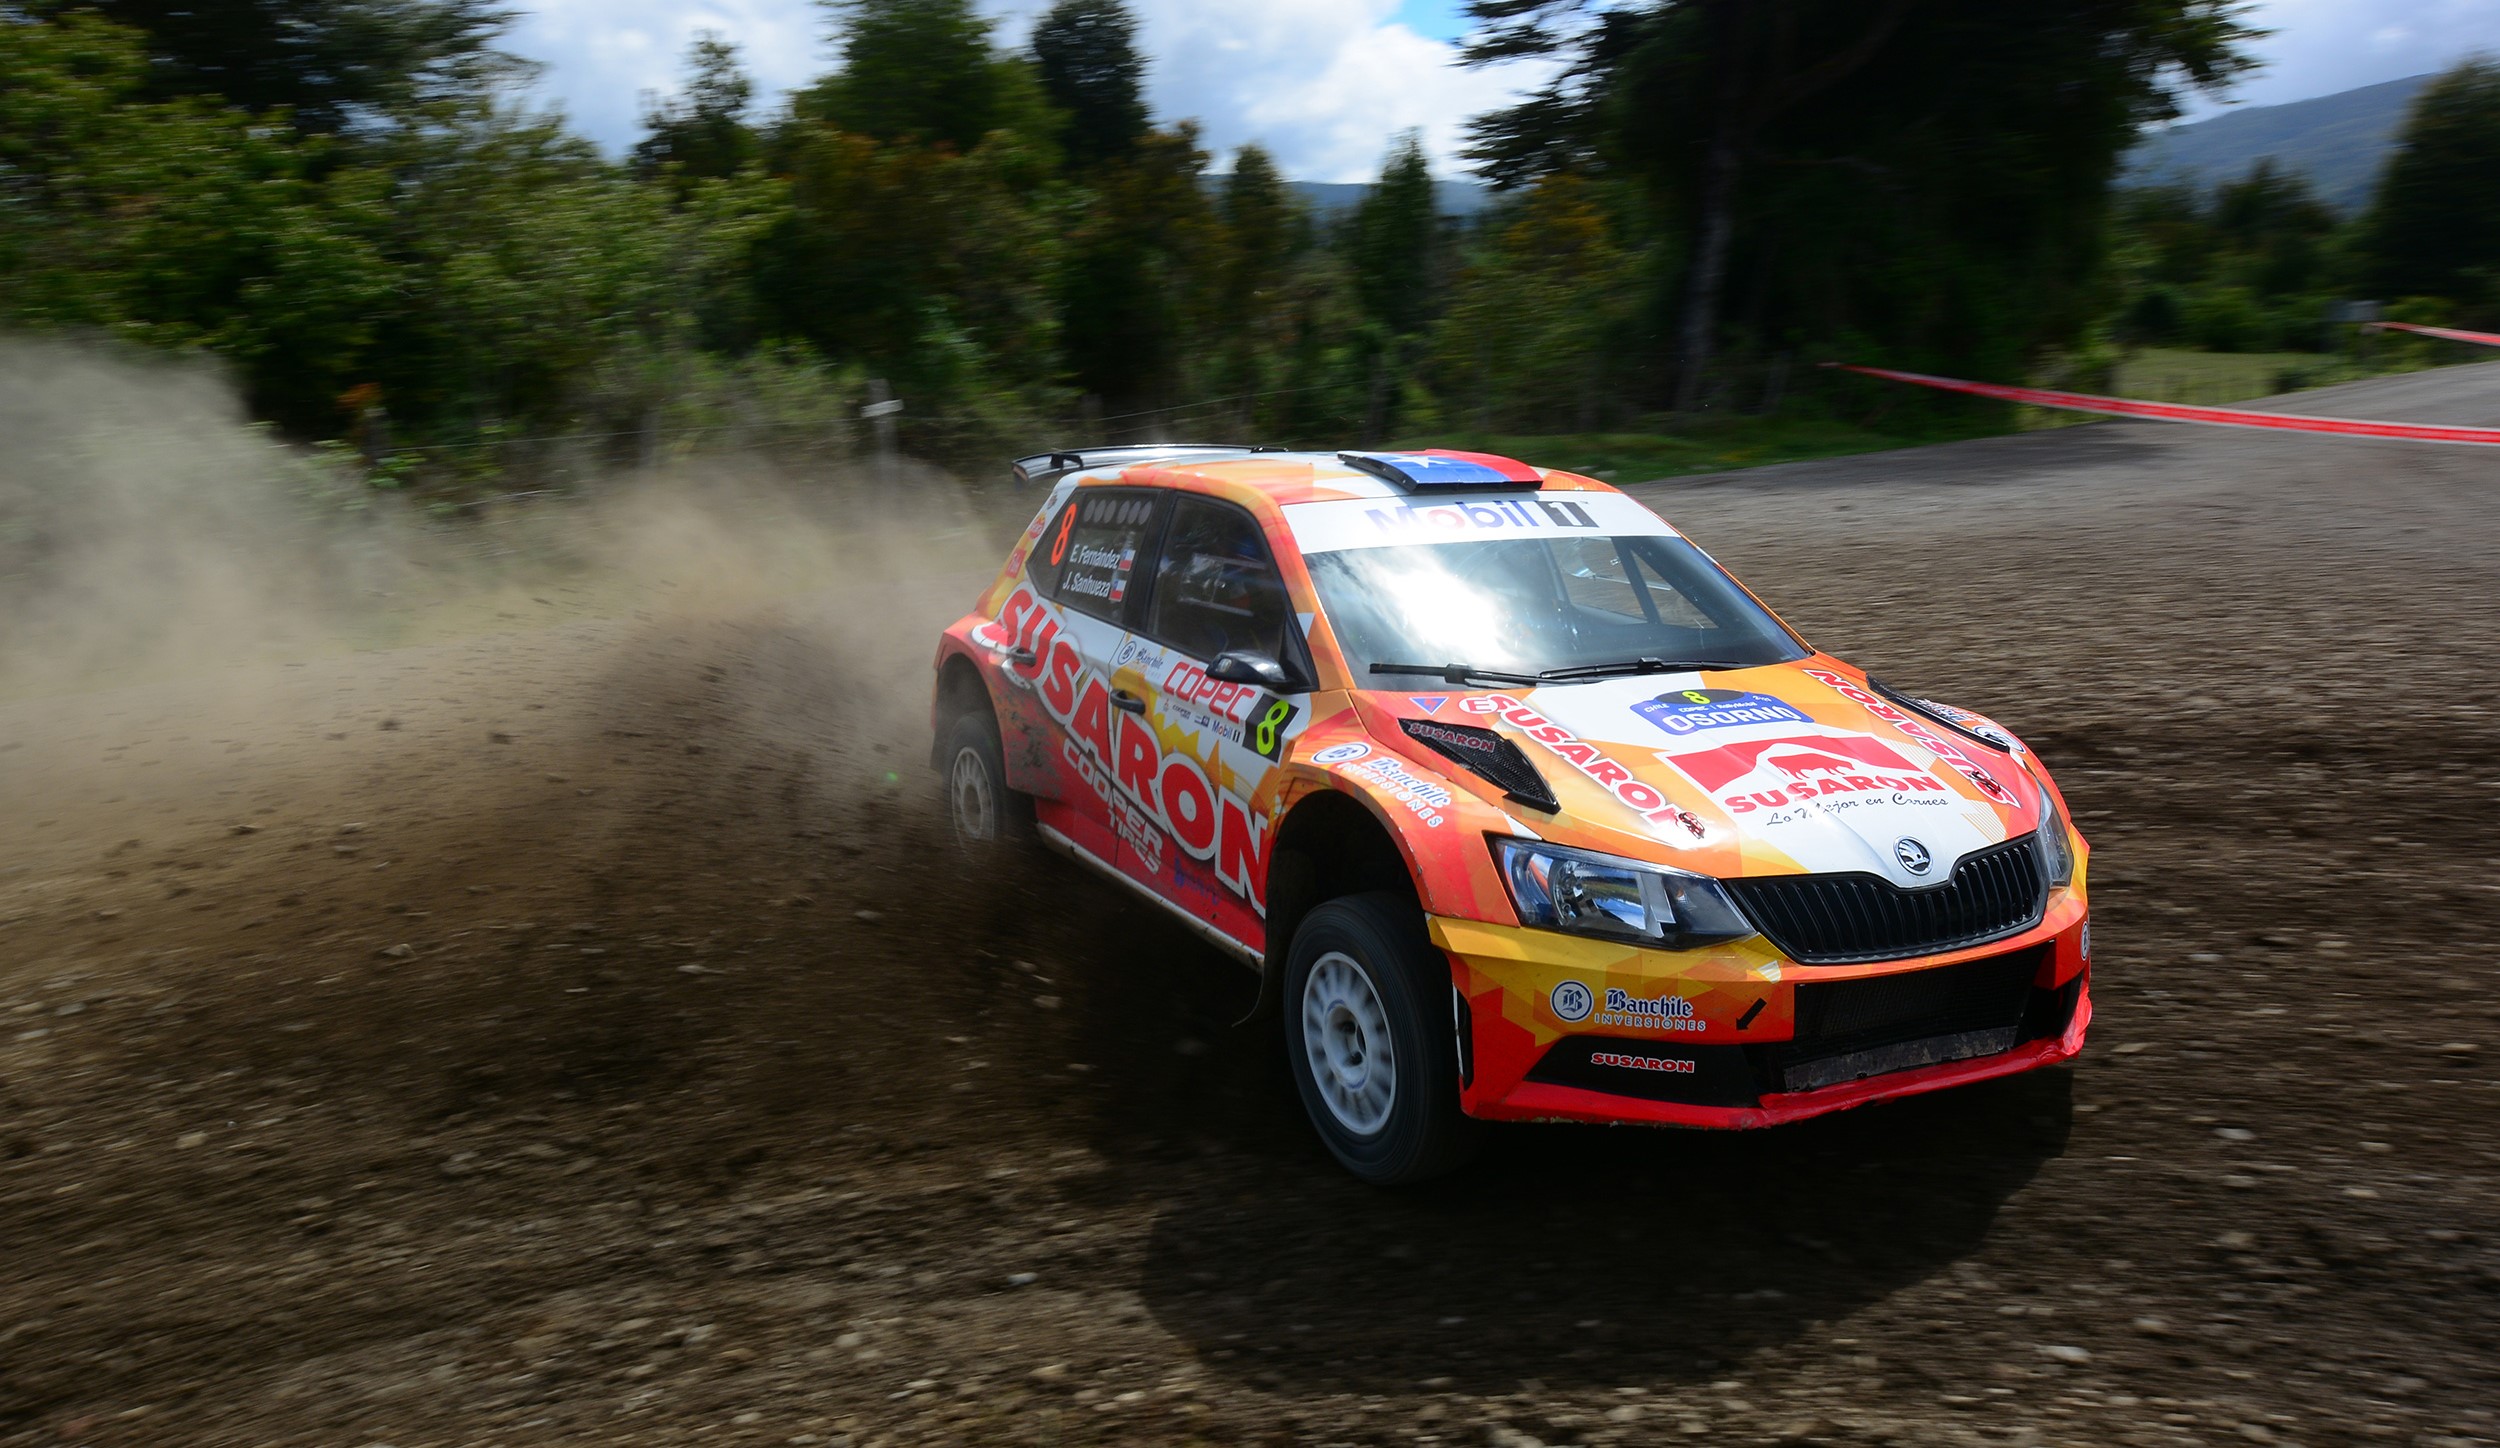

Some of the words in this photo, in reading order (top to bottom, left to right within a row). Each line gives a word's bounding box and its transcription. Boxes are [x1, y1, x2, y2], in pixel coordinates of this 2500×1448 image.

[1365, 500, 1539, 534] Mobil
[1051, 503, 1077, 566] 8
[1078, 545, 1121, 569] Fernández
[1062, 571, 1073, 590] J.
[1071, 572, 1111, 598] Sanhueza
[1643, 703, 1670, 713] CHILE
[1681, 691, 1711, 704] 8
[1212, 720, 1234, 740] Mobil
[1257, 700, 1289, 755] 8
[1662, 705, 1802, 731] OSORNO
[976, 586, 1268, 915] SUSARON
[1408, 722, 1495, 752] SUSARON
[1337, 762, 1444, 827] INVERSIONES
[1365, 757, 1451, 807] Banchile
[1724, 776, 1946, 813] SUSARON
[1063, 738, 1163, 858] COOPER
[1865, 797, 1884, 806] en
[1108, 808, 1161, 874] TIRES
[1605, 989, 1693, 1018] Banchile
[1595, 1014, 1706, 1032] INVERSIONES
[1591, 1053, 1695, 1073] SUSARON
